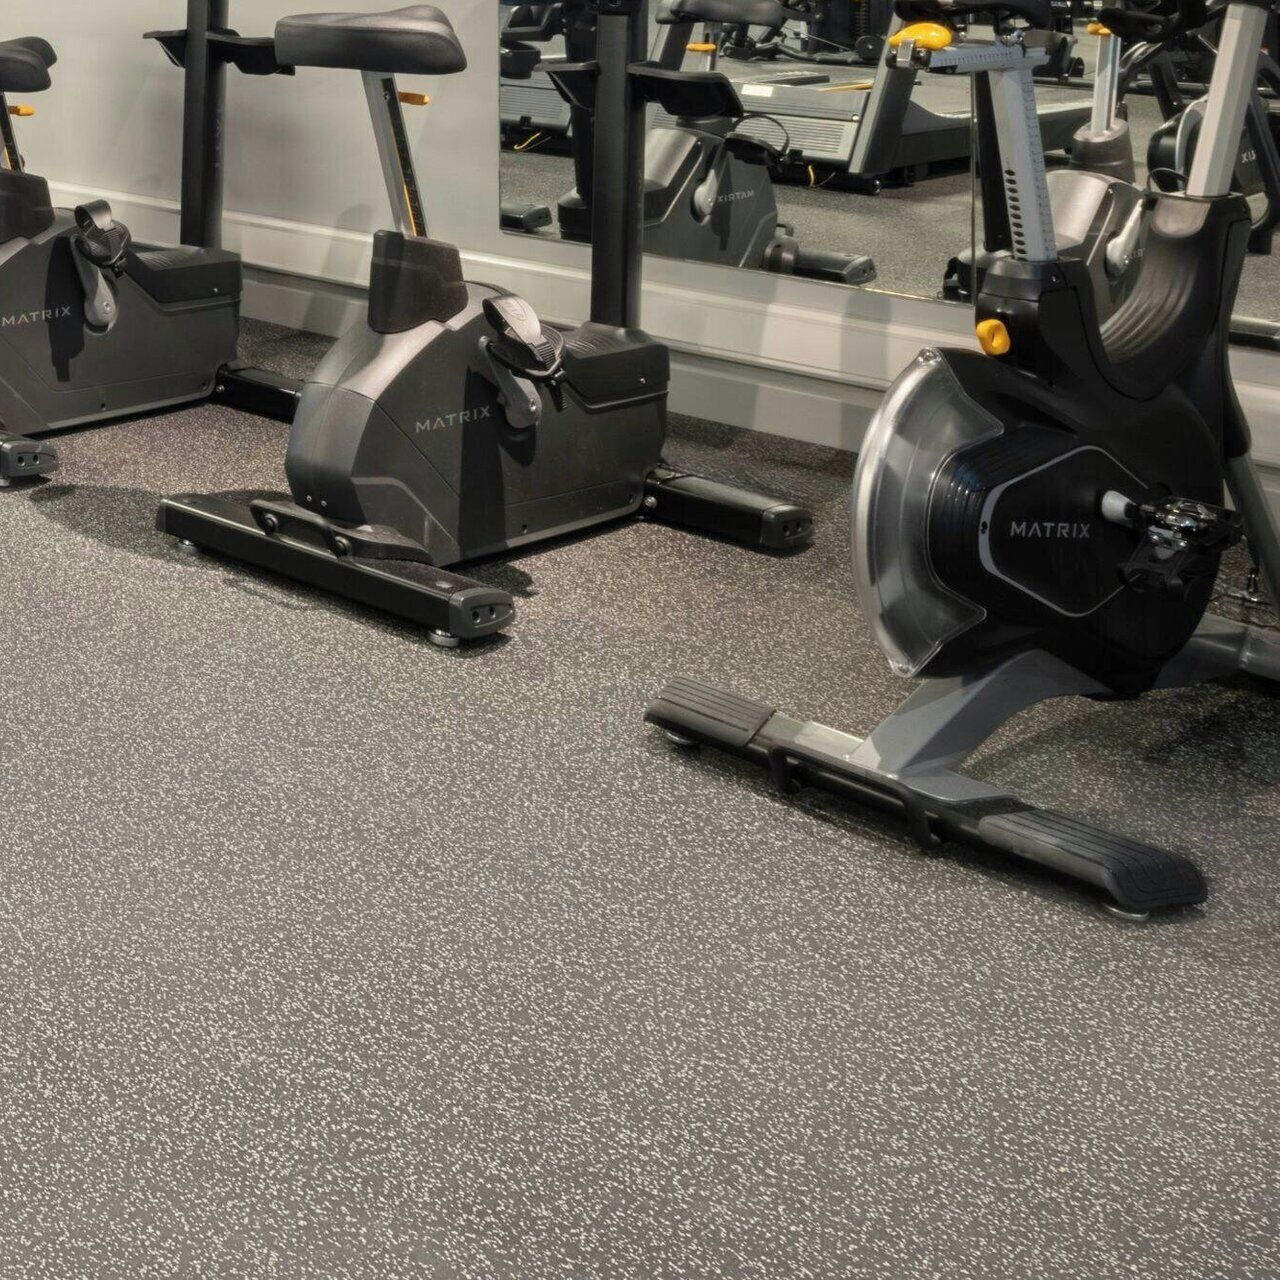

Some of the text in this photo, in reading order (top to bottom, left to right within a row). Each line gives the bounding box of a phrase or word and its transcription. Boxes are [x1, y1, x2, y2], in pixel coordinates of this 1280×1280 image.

[1, 306, 72, 327] MATRIX
[416, 405, 491, 433] MATRIX
[1010, 520, 1090, 538] MATRIX
